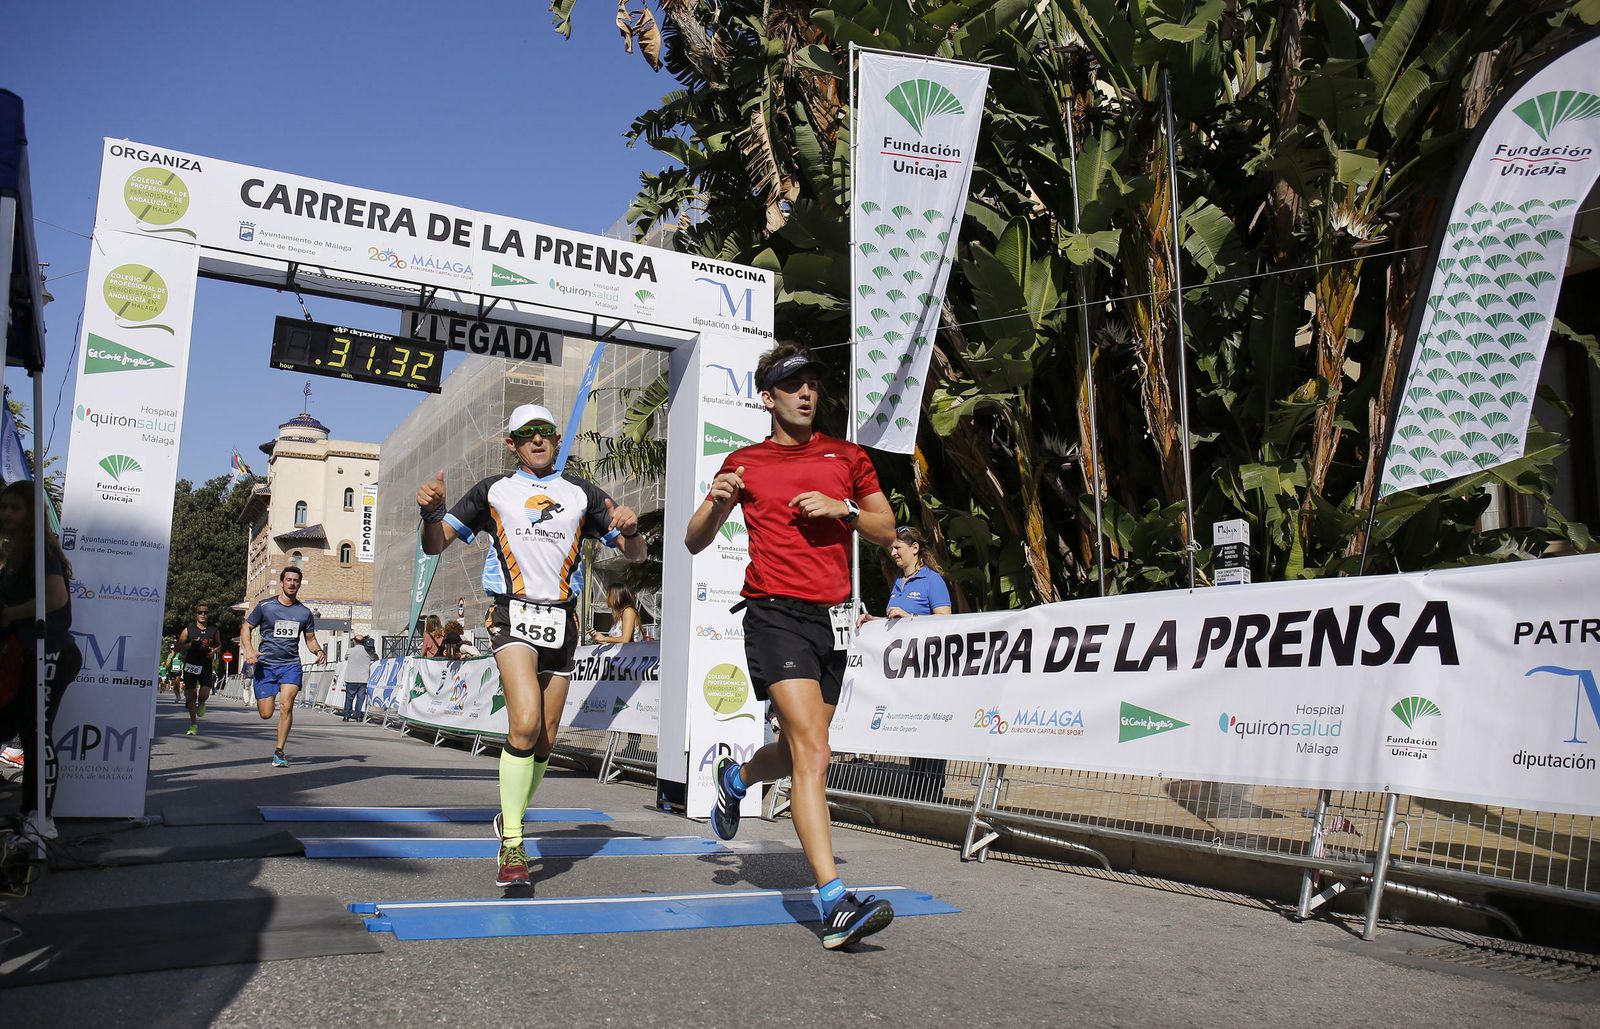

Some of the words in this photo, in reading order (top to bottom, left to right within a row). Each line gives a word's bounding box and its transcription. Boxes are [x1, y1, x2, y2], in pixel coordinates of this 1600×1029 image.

[883, 136, 961, 157] Fundación
[1495, 144, 1592, 157] Fundación
[110, 145, 202, 172] ORGANIZA
[893, 160, 947, 180] Unicaja
[1501, 161, 1567, 177] Unicaja
[131, 175, 163, 185] COLEGIO
[130, 182, 177, 195] PROFESIONAL
[240, 178, 417, 238] CARRERA
[427, 213, 474, 248] DE
[481, 223, 525, 258] LA
[533, 234, 658, 283] PRENSA
[259, 229, 312, 245] Ayuntamiento
[325, 241, 352, 252] Málaga
[288, 245, 316, 256] Deporte
[368, 246, 407, 269] 2020
[411, 253, 474, 276] MÁLAGA
[110, 272, 142, 282] COLEGIO
[691, 261, 766, 283] PATROCINA
[109, 279, 156, 292] PROFESIONAL
[109, 285, 151, 297] PERIODISTAS
[593, 282, 620, 292] Hospital
[692, 316, 730, 330] diputación
[731, 323, 740, 331] de
[742, 325, 773, 339] málaga
[410, 312, 553, 364] LLEGADA
[279, 361, 294, 370] hour
[141, 405, 178, 418] Hospital
[90, 411, 176, 433] quirónsalud
[141, 433, 175, 446] Málaga
[96, 482, 141, 493] Fundación
[102, 494, 133, 504] Unicaja
[80, 535, 129, 546] Ayuntamiento
[130, 538, 139, 547] de
[140, 540, 165, 550] Málaga
[97, 546, 106, 554] de
[107, 547, 133, 556] Deporte
[721, 554, 743, 562] Unicaja
[99, 582, 160, 598] MÁLAGA
[276, 628, 294, 636] 593
[516, 622, 556, 643] 458
[883, 628, 1033, 680] CARRERA
[1043, 624, 1110, 673] DE
[1113, 620, 1178, 673] LA
[1191, 600, 1460, 669] PRENSA
[98, 675, 109, 685] de
[112, 675, 153, 688] málaga
[1013, 706, 1084, 728] MÁLAGA
[1296, 704, 1345, 717] Hospital
[886, 712, 922, 721] Ayuntamiento
[923, 713, 931, 721] de
[932, 712, 953, 723] Málaga
[974, 708, 1009, 735] 2020
[899, 725, 917, 733] Deporte
[1235, 718, 1341, 739] quirónsalud
[1386, 735, 1438, 747] Fundación
[1296, 742, 1339, 757] Málaga
[1391, 748, 1428, 760] Unicaja
[1512, 749, 1596, 771] diputación
